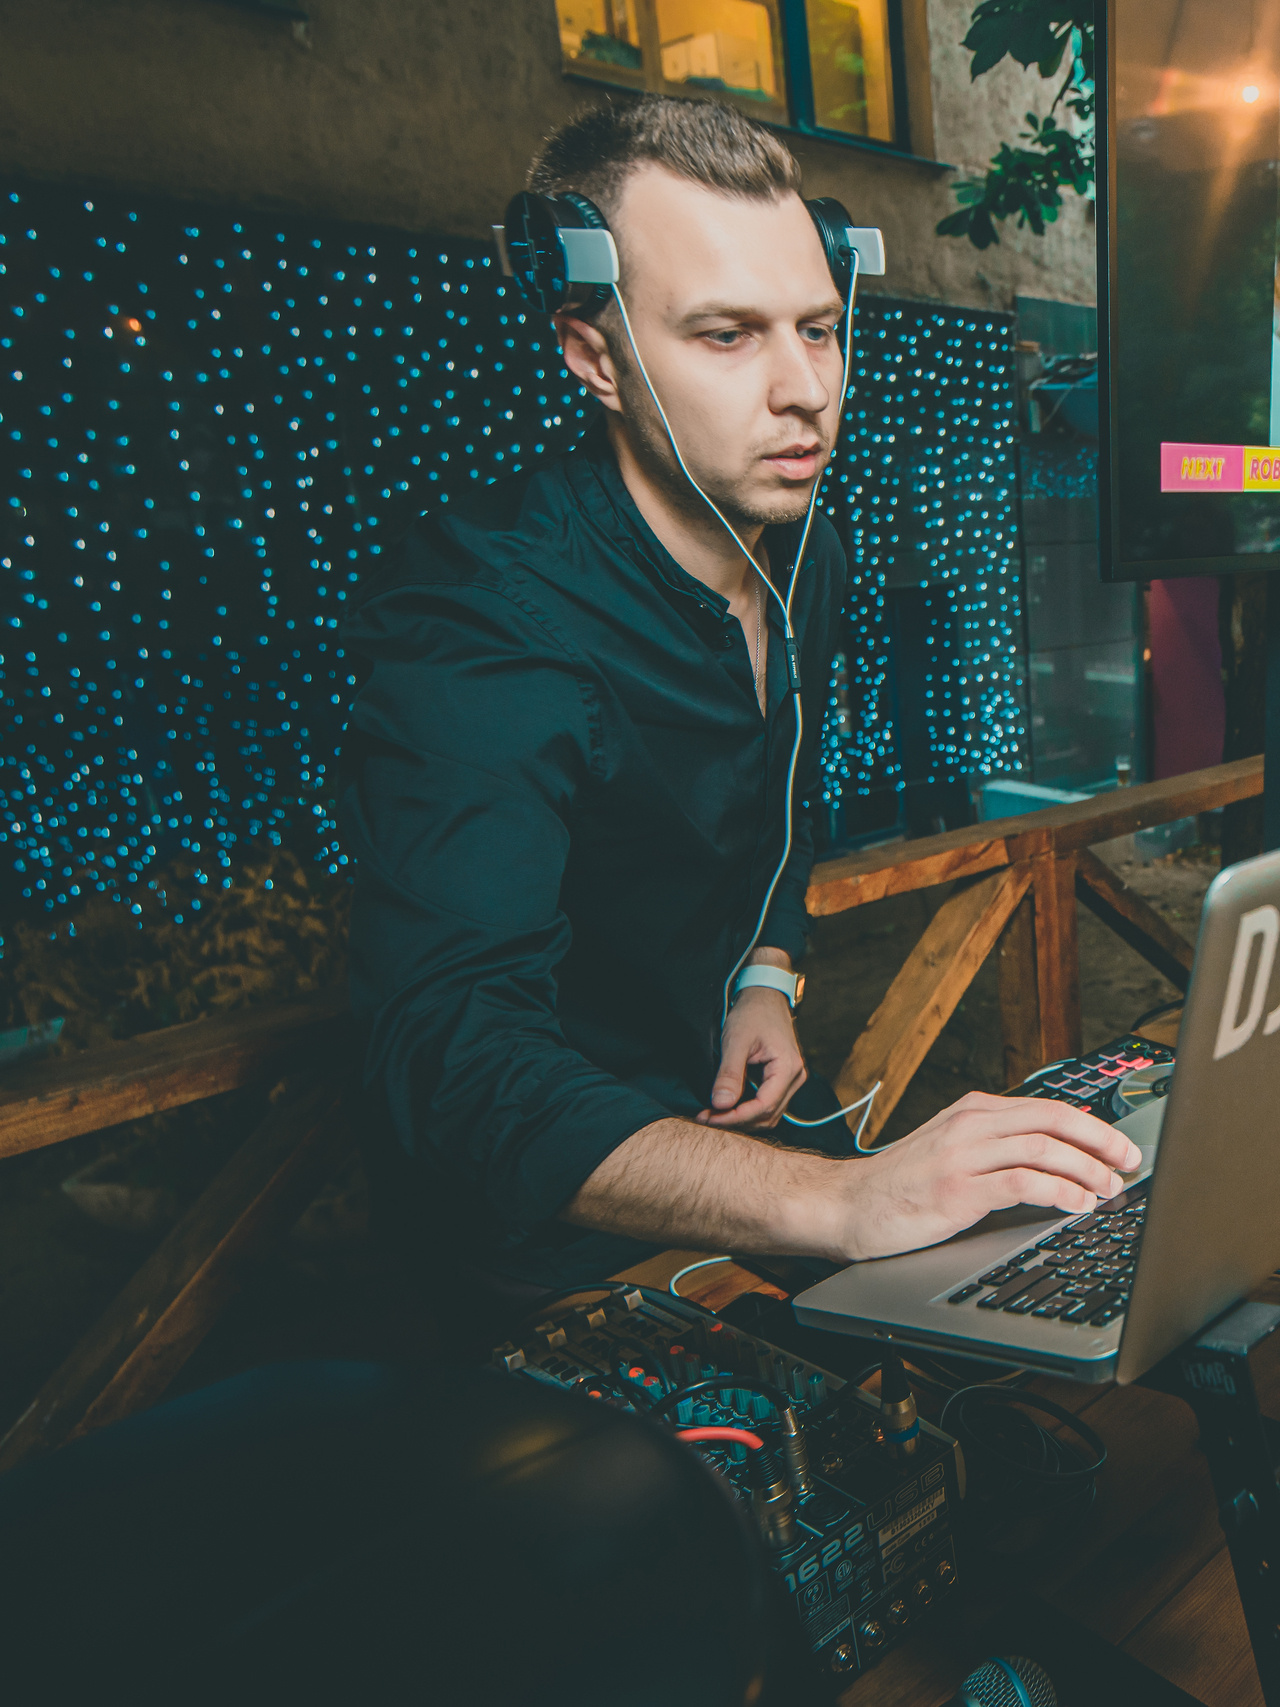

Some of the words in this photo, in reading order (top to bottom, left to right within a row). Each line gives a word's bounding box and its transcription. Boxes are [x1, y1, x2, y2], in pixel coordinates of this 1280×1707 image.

[1180, 456, 1226, 481] NEXT
[784, 1522, 865, 1593] 1622
[867, 1462, 944, 1531] USB
